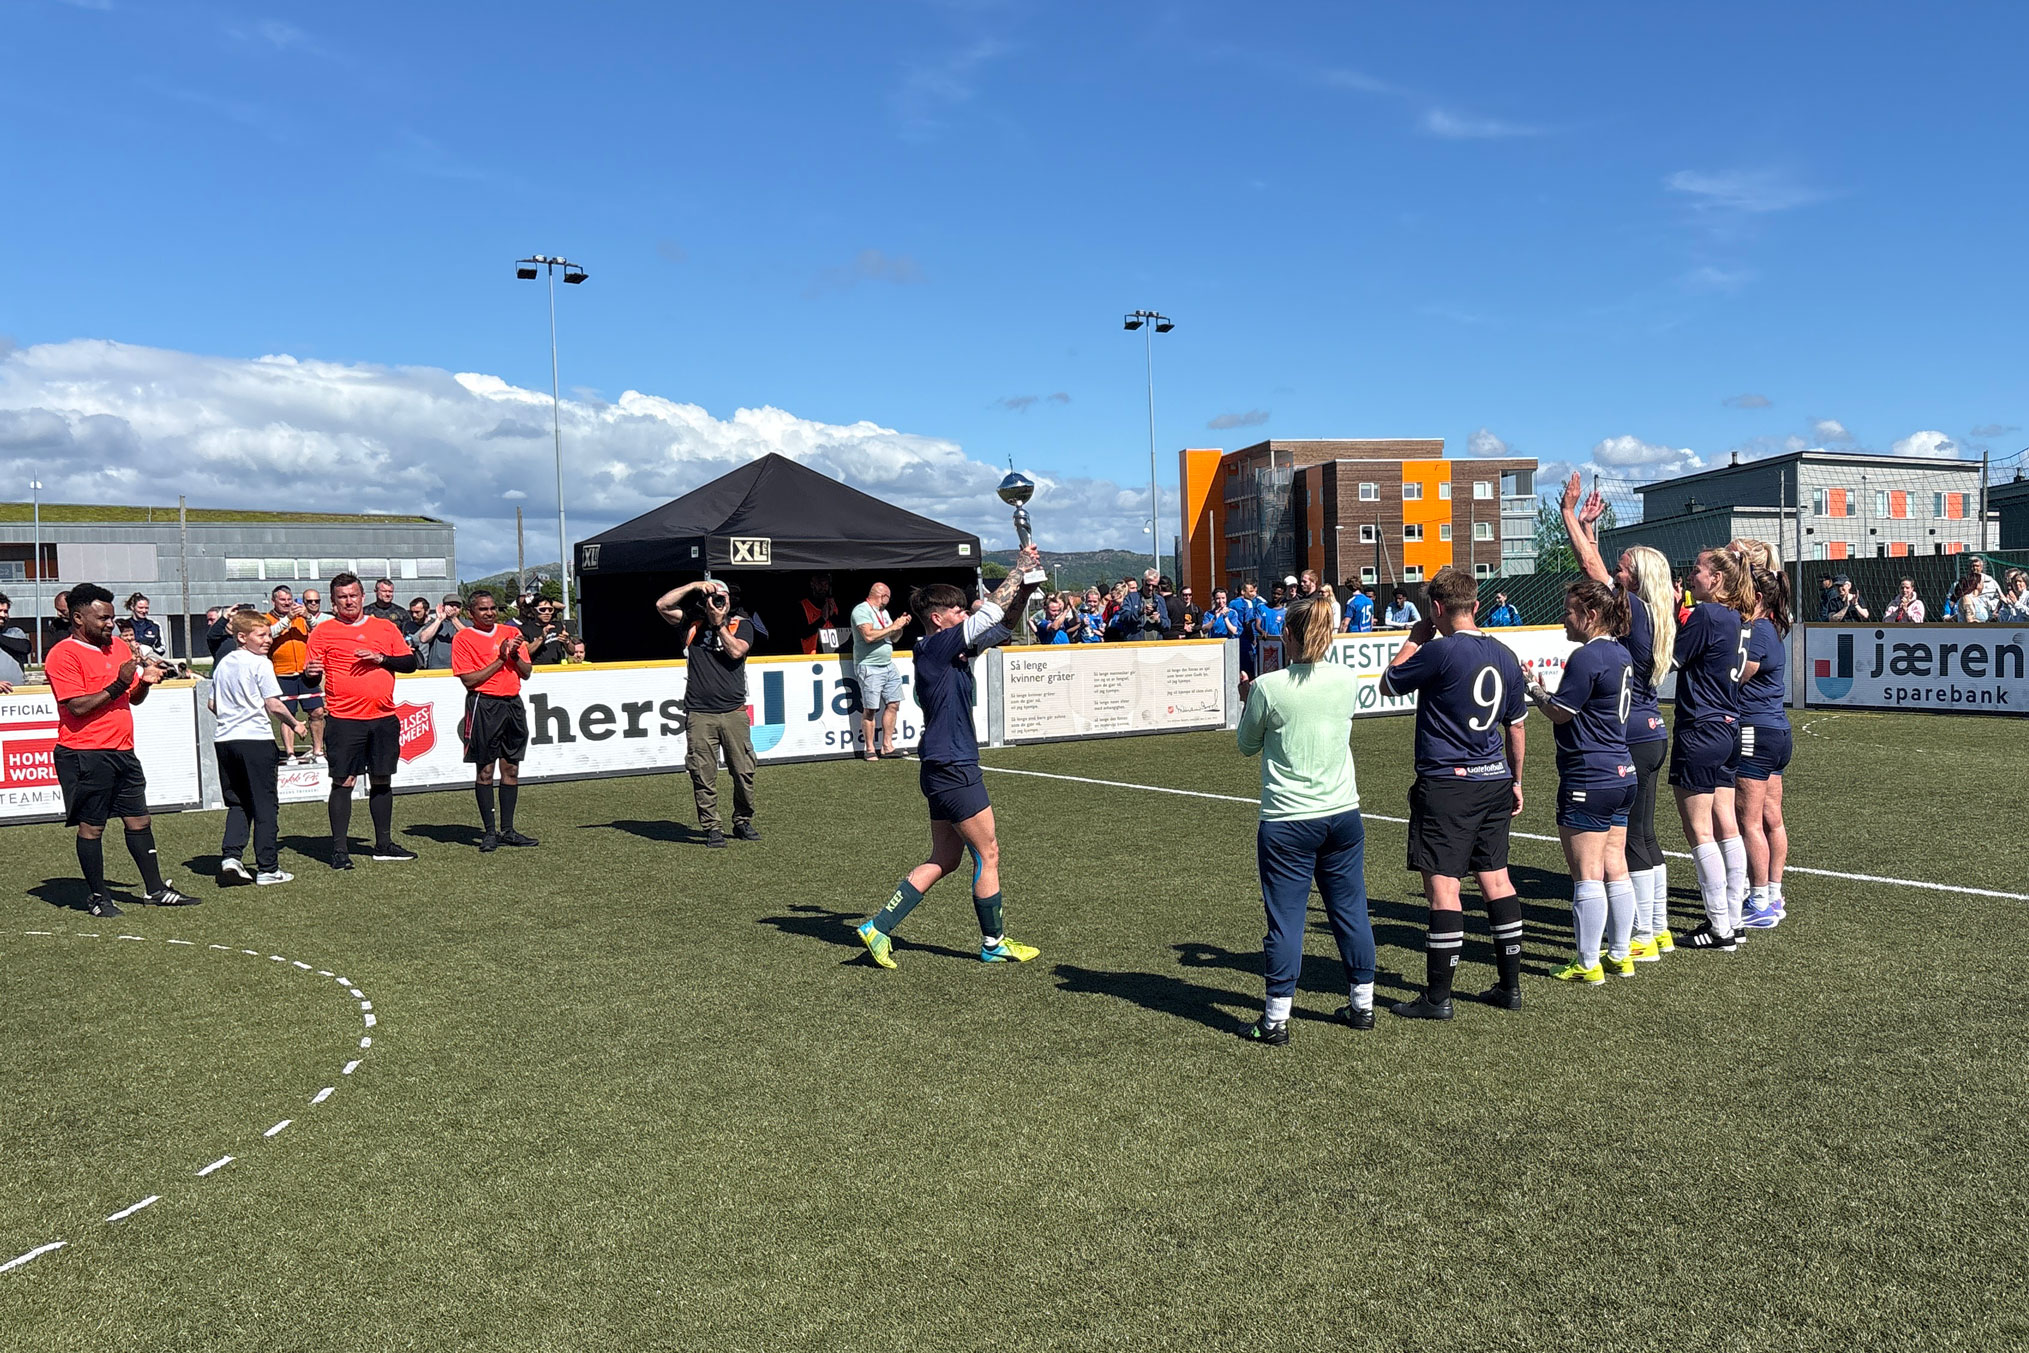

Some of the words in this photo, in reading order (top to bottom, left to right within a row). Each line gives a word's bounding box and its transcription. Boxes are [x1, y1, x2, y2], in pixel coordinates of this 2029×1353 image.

[1361, 605, 1371, 624] 15
[1010, 660, 1021, 670] Så
[1024, 660, 1048, 672] lenge
[1323, 643, 1399, 668] MESTE
[1730, 629, 1751, 682] 5
[1870, 629, 2024, 679] jæren
[1010, 673, 1045, 683] kvinner
[1047, 671, 1075, 684] gråter
[1469, 666, 1503, 731] 9
[1618, 665, 1633, 724] 6
[1883, 684, 2009, 704] sparebank
[457, 693, 687, 745] hers
[885, 889, 904, 912] KEEP
